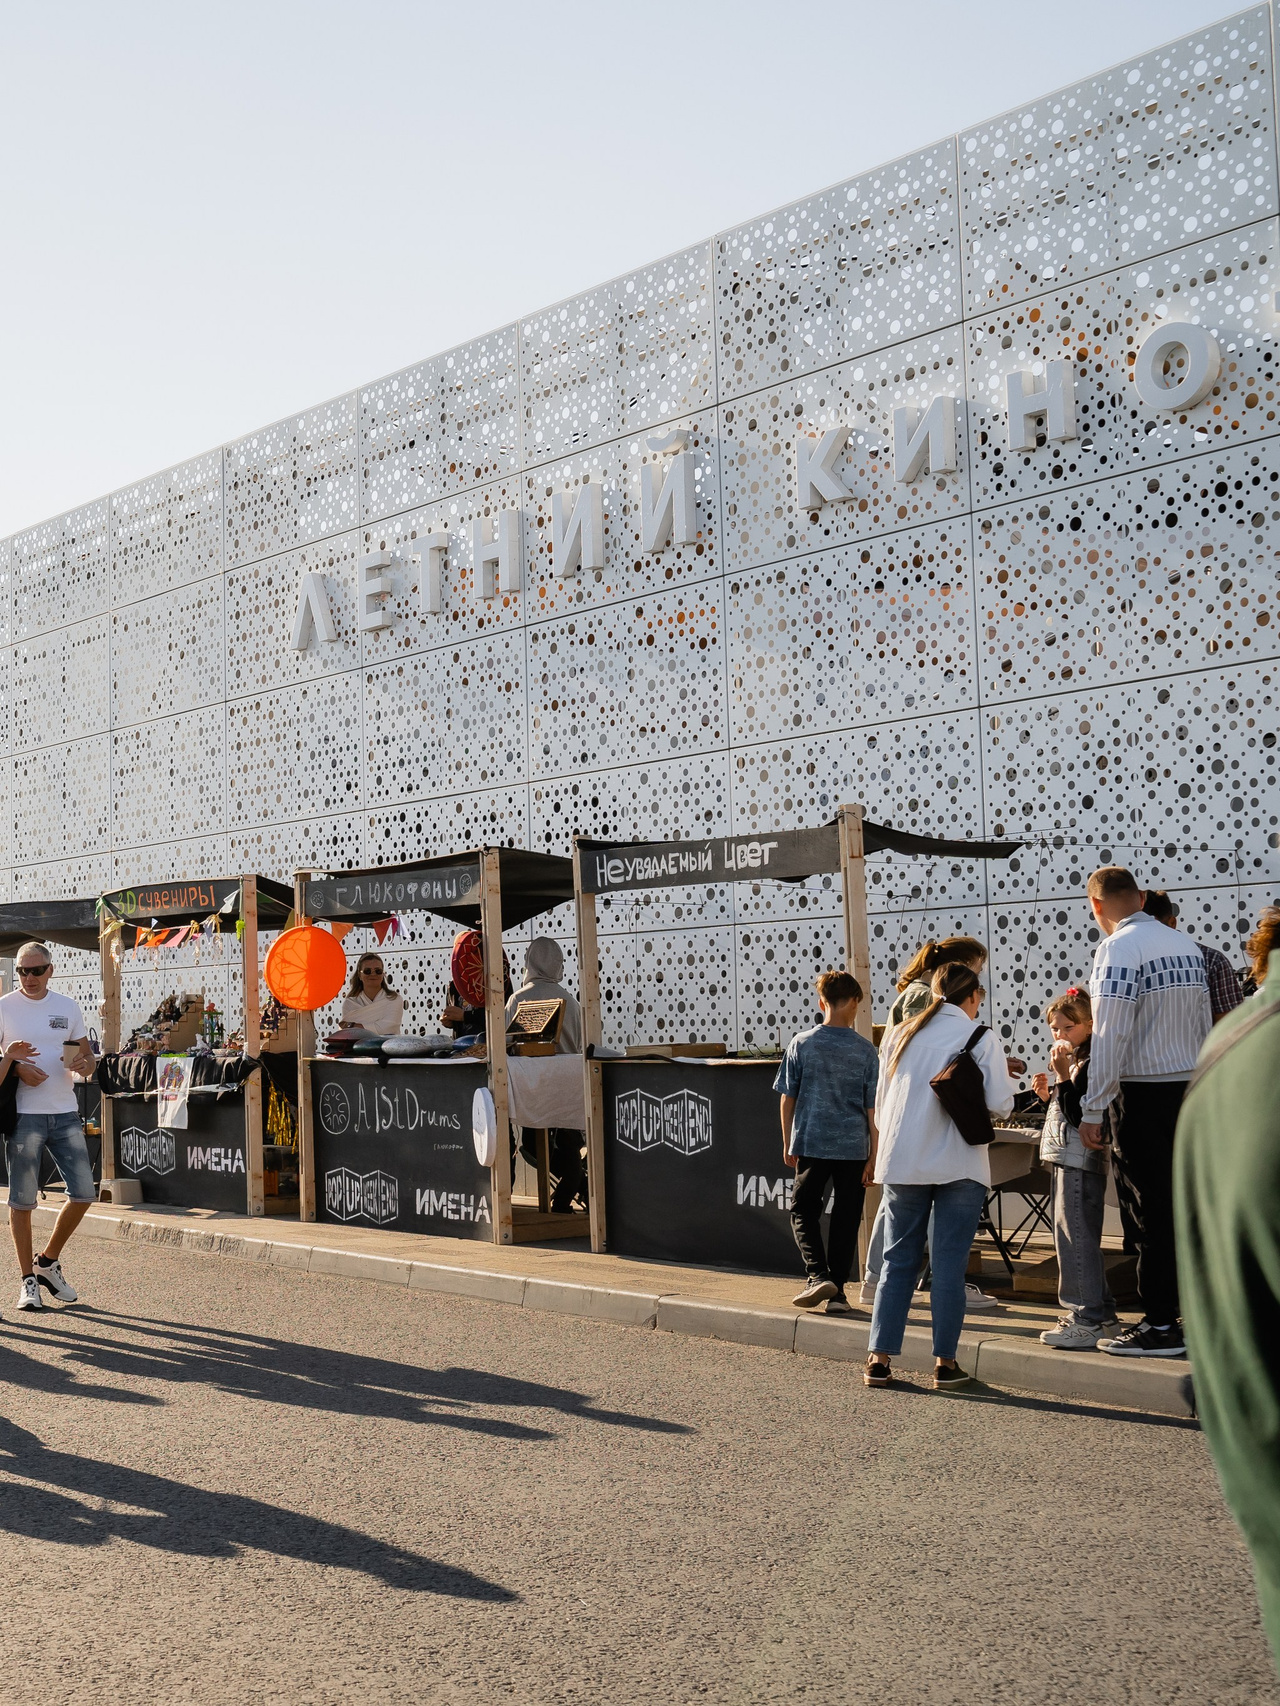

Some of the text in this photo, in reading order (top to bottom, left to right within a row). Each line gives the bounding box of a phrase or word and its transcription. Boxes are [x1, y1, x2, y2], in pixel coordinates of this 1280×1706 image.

[288, 320, 1222, 652] ЛЕТНИЙ КИНО
[117, 890, 137, 915] 3D
[619, 1098, 638, 1140] POP
[642, 1099, 660, 1142] UP
[135, 1134, 147, 1166] UP
[186, 1145, 246, 1174] ИМЕНА
[327, 1174, 343, 1211] POP
[346, 1176, 361, 1212] UP
[415, 1188, 491, 1225] ИМЕНА
